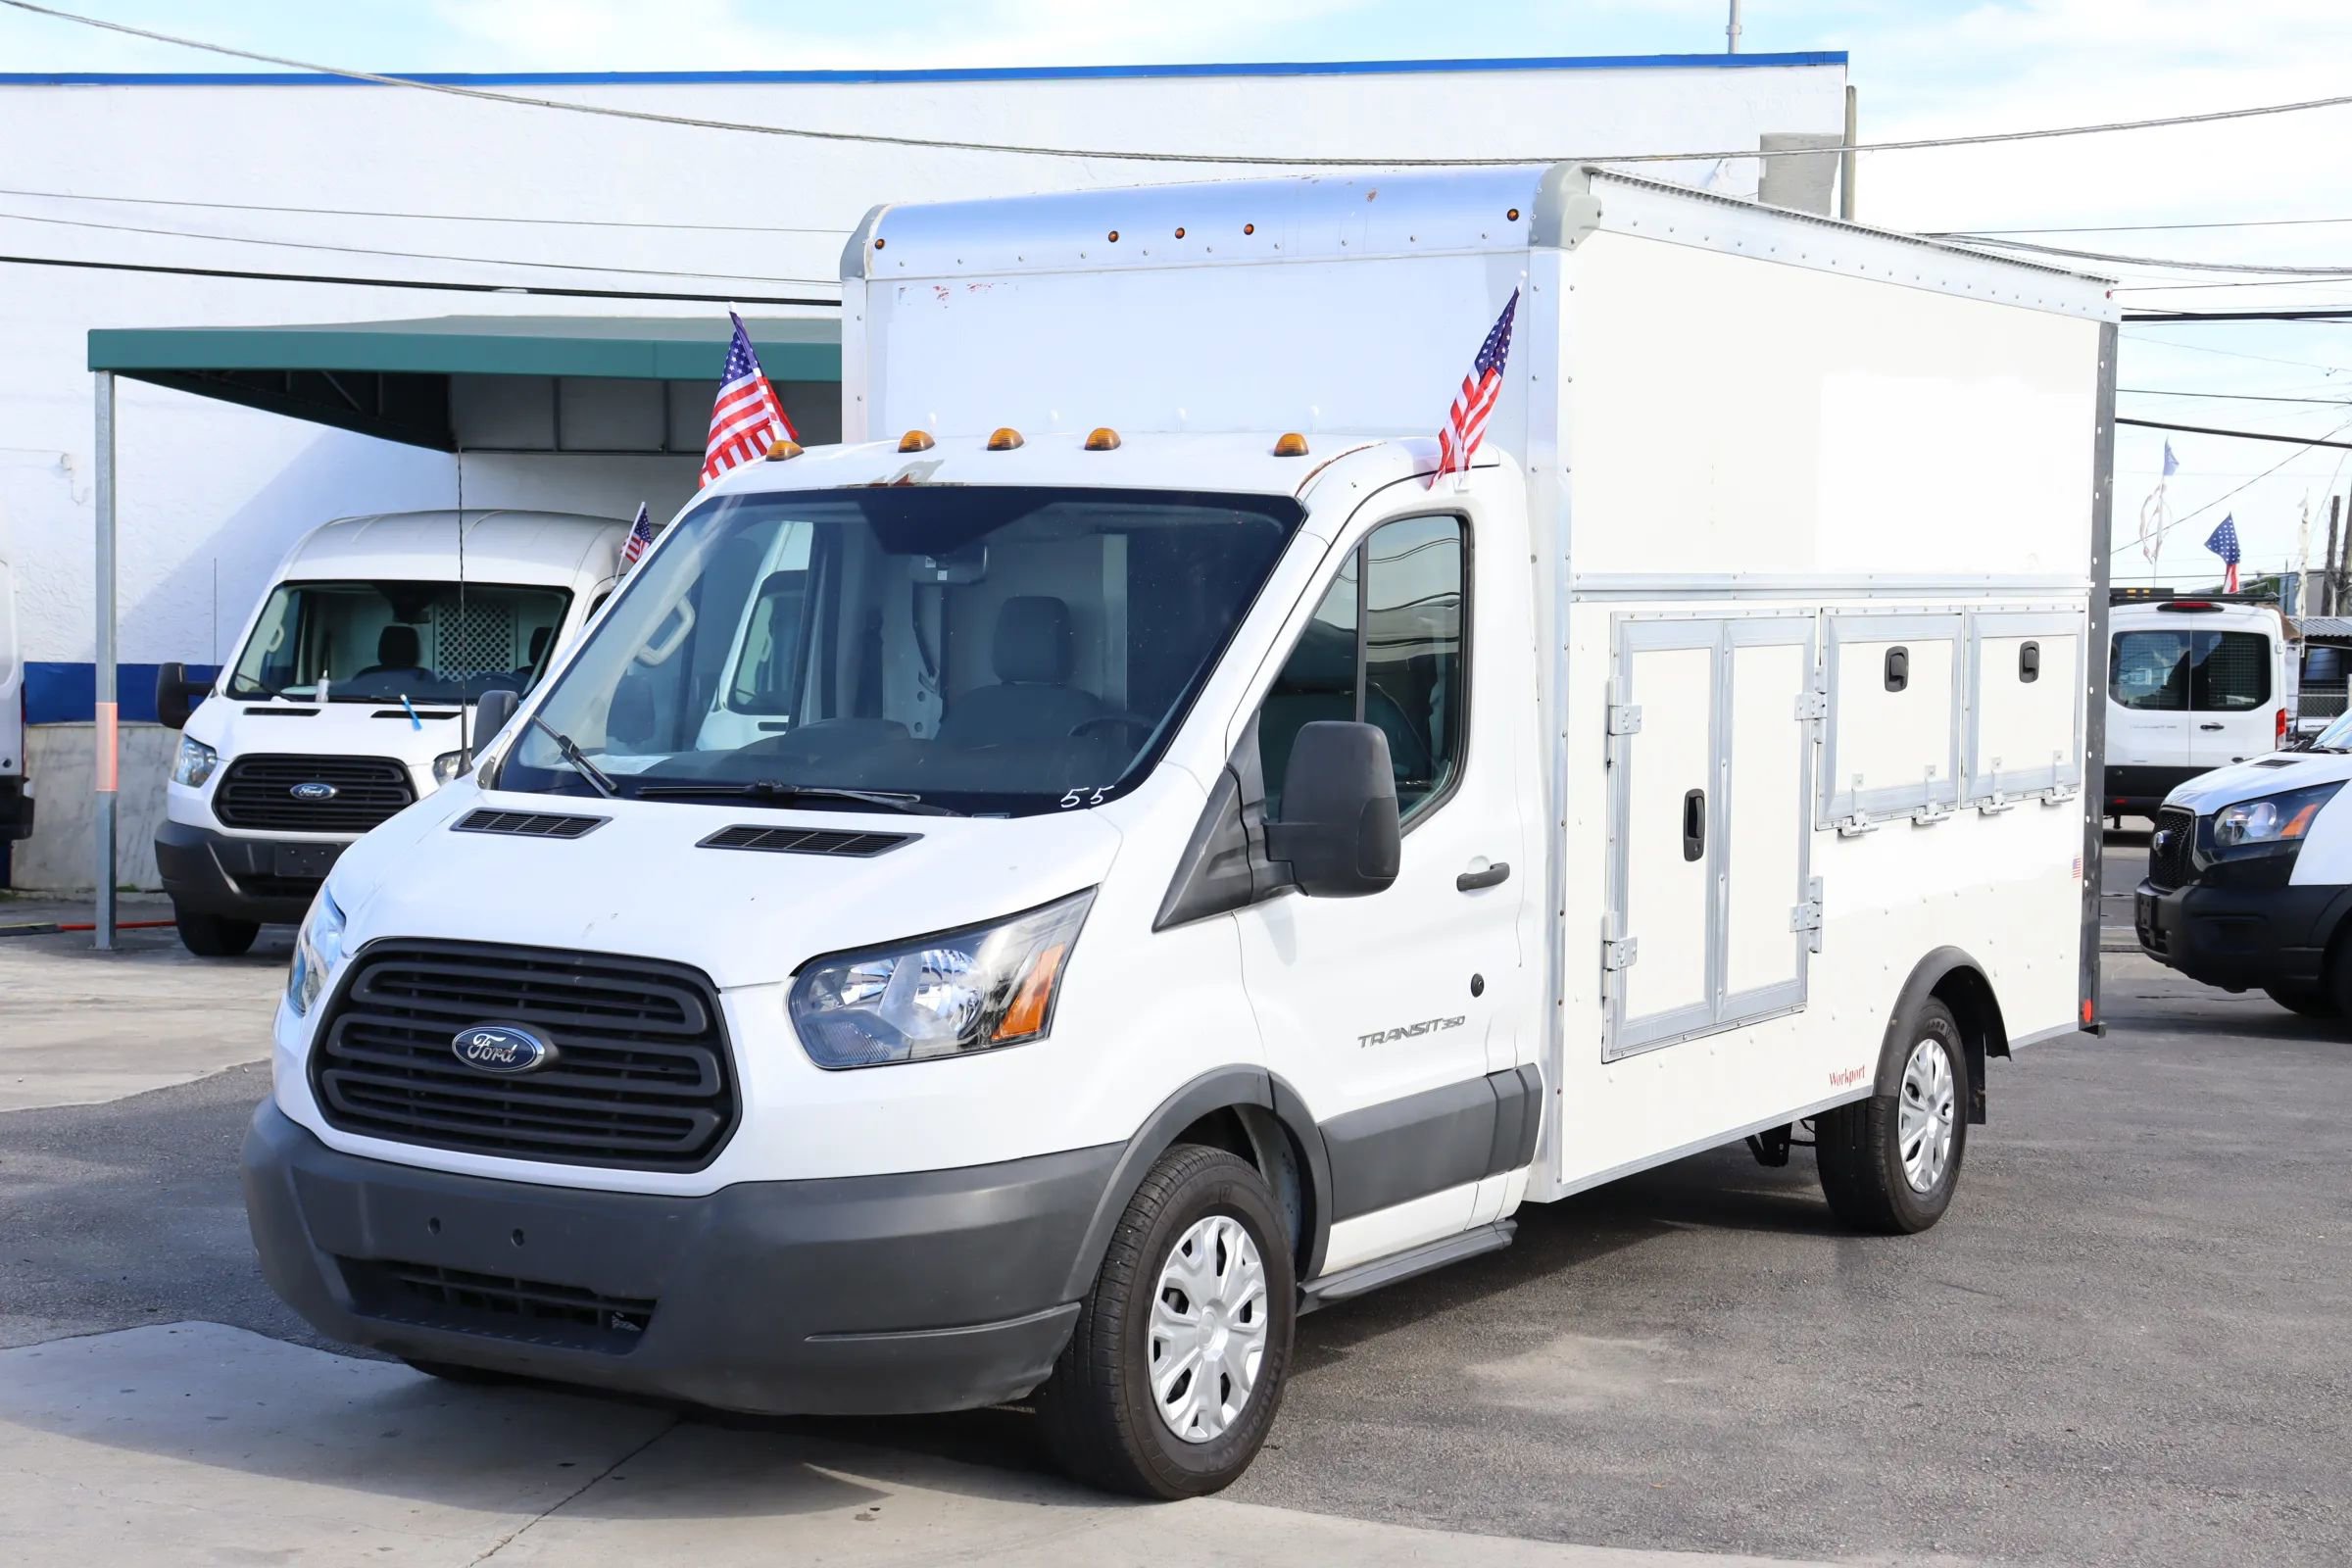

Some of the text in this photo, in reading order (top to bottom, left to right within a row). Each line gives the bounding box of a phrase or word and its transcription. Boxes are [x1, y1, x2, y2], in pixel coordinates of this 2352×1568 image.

[1060, 785, 1115, 808] 55
[467, 1033, 517, 1063] Ford
[1829, 1064, 1865, 1087] Workport
